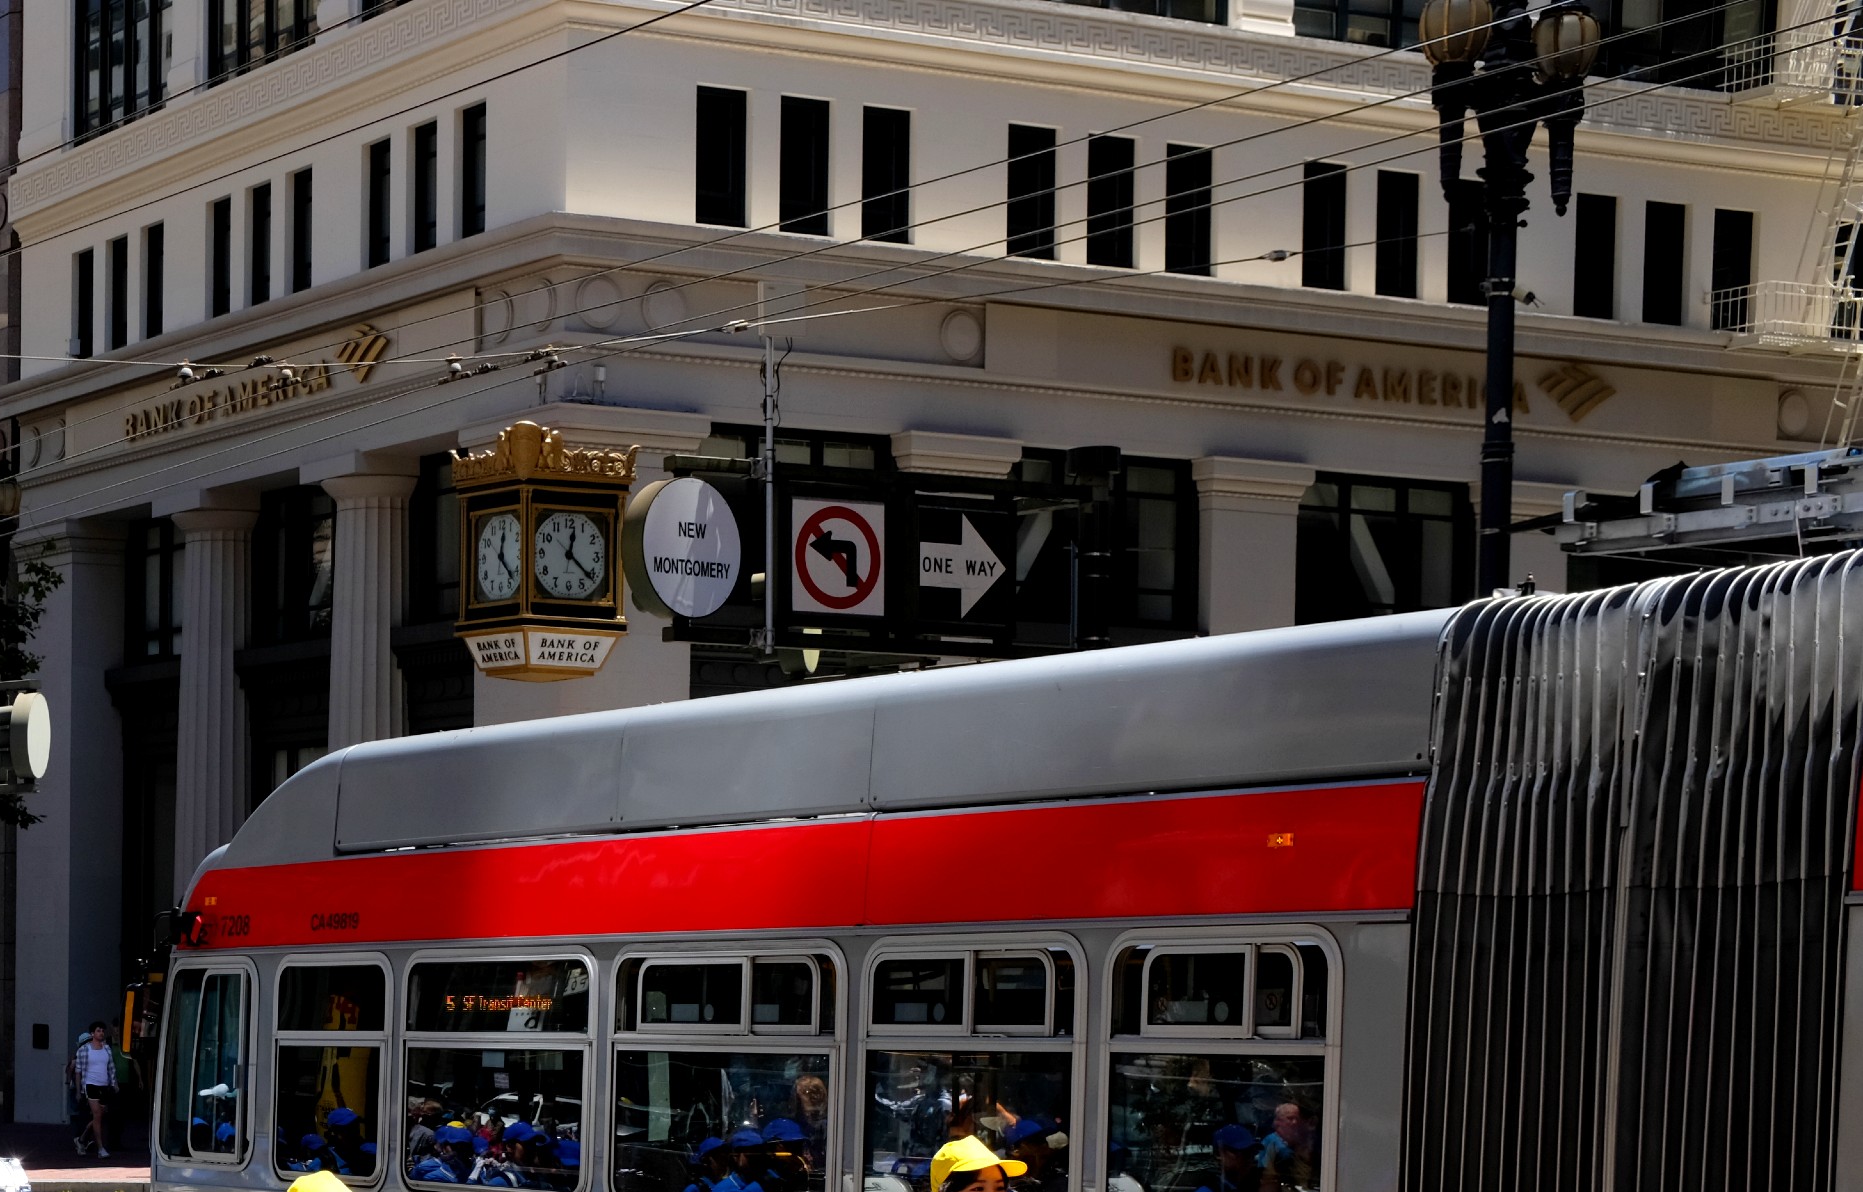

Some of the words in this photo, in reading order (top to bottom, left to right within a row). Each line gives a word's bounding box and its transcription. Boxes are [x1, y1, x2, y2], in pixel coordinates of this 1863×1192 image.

[1170, 345, 1284, 391] BANK
[1292, 357, 1346, 396] OF
[1354, 366, 1530, 415] AMERIA
[124, 399, 184, 441] BANK
[188, 389, 217, 425] OF
[221, 358, 333, 418] AMERICA
[552, 522, 560, 533] 11
[565, 518, 575, 530] 12
[581, 523, 585, 533] 1
[678, 521, 707, 539] NEW
[542, 533, 553, 543] 10
[589, 534, 596, 545] 2
[538, 548, 545, 559] 9
[593, 552, 600, 563] 3
[542, 565, 549, 575] 8
[653, 556, 730, 579] MONTGOMERY
[922, 556, 954, 574] ONE
[965, 560, 997, 577] WAY
[553, 577, 559, 588] 7
[566, 581, 572, 591] 6
[579, 579, 585, 590] 5
[476, 639, 501, 651] BANK
[505, 638, 516, 649] OF
[540, 638, 575, 650] BANK
[583, 641, 600, 651] OF
[481, 651, 520, 664] AMERICA
[538, 652, 595, 663] AMERICA
[310, 913, 359, 931] CA49819
[446, 996, 455, 1011] 5
[463, 995, 475, 1011] SF
[479, 995, 514, 1011] Transit
[517, 995, 553, 1010] Center
